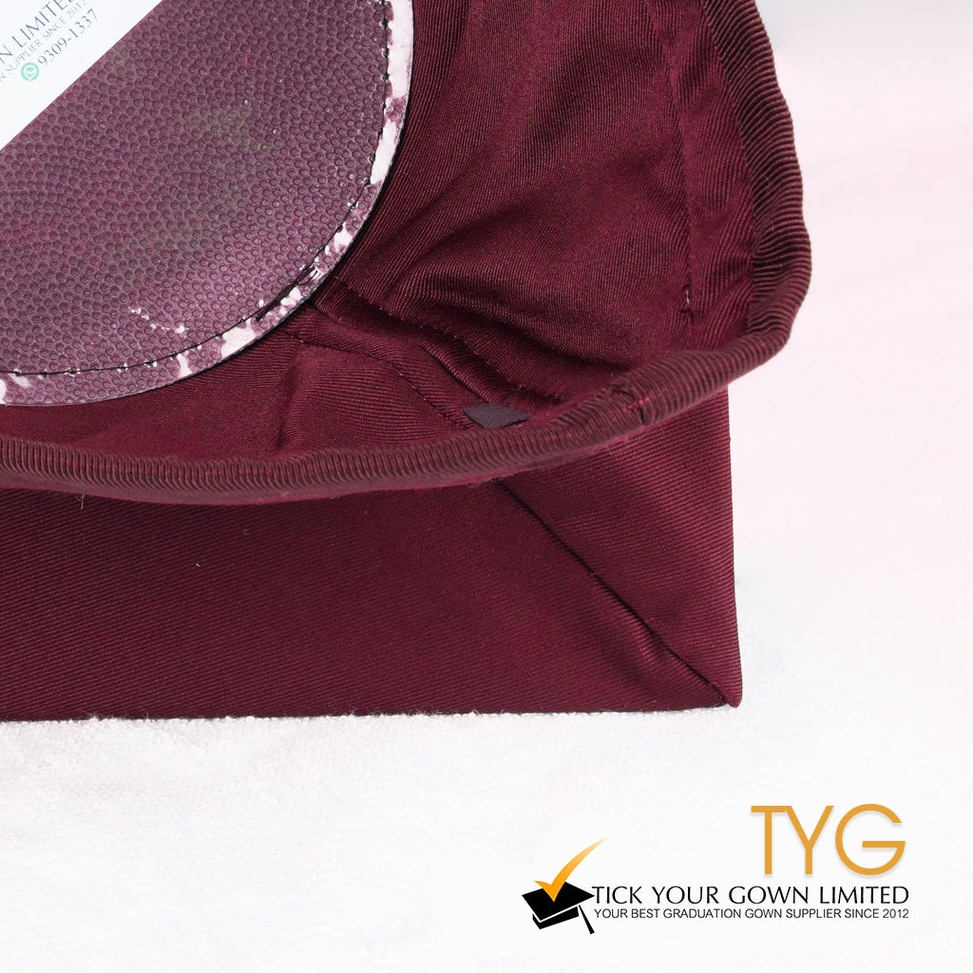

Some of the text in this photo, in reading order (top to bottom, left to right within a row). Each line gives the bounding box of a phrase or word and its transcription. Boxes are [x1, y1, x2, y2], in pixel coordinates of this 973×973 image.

[5, 38, 43, 75] SUPPLIER
[41, 15, 67, 40] SINCE
[37, 8, 99, 67] 9309-1337
